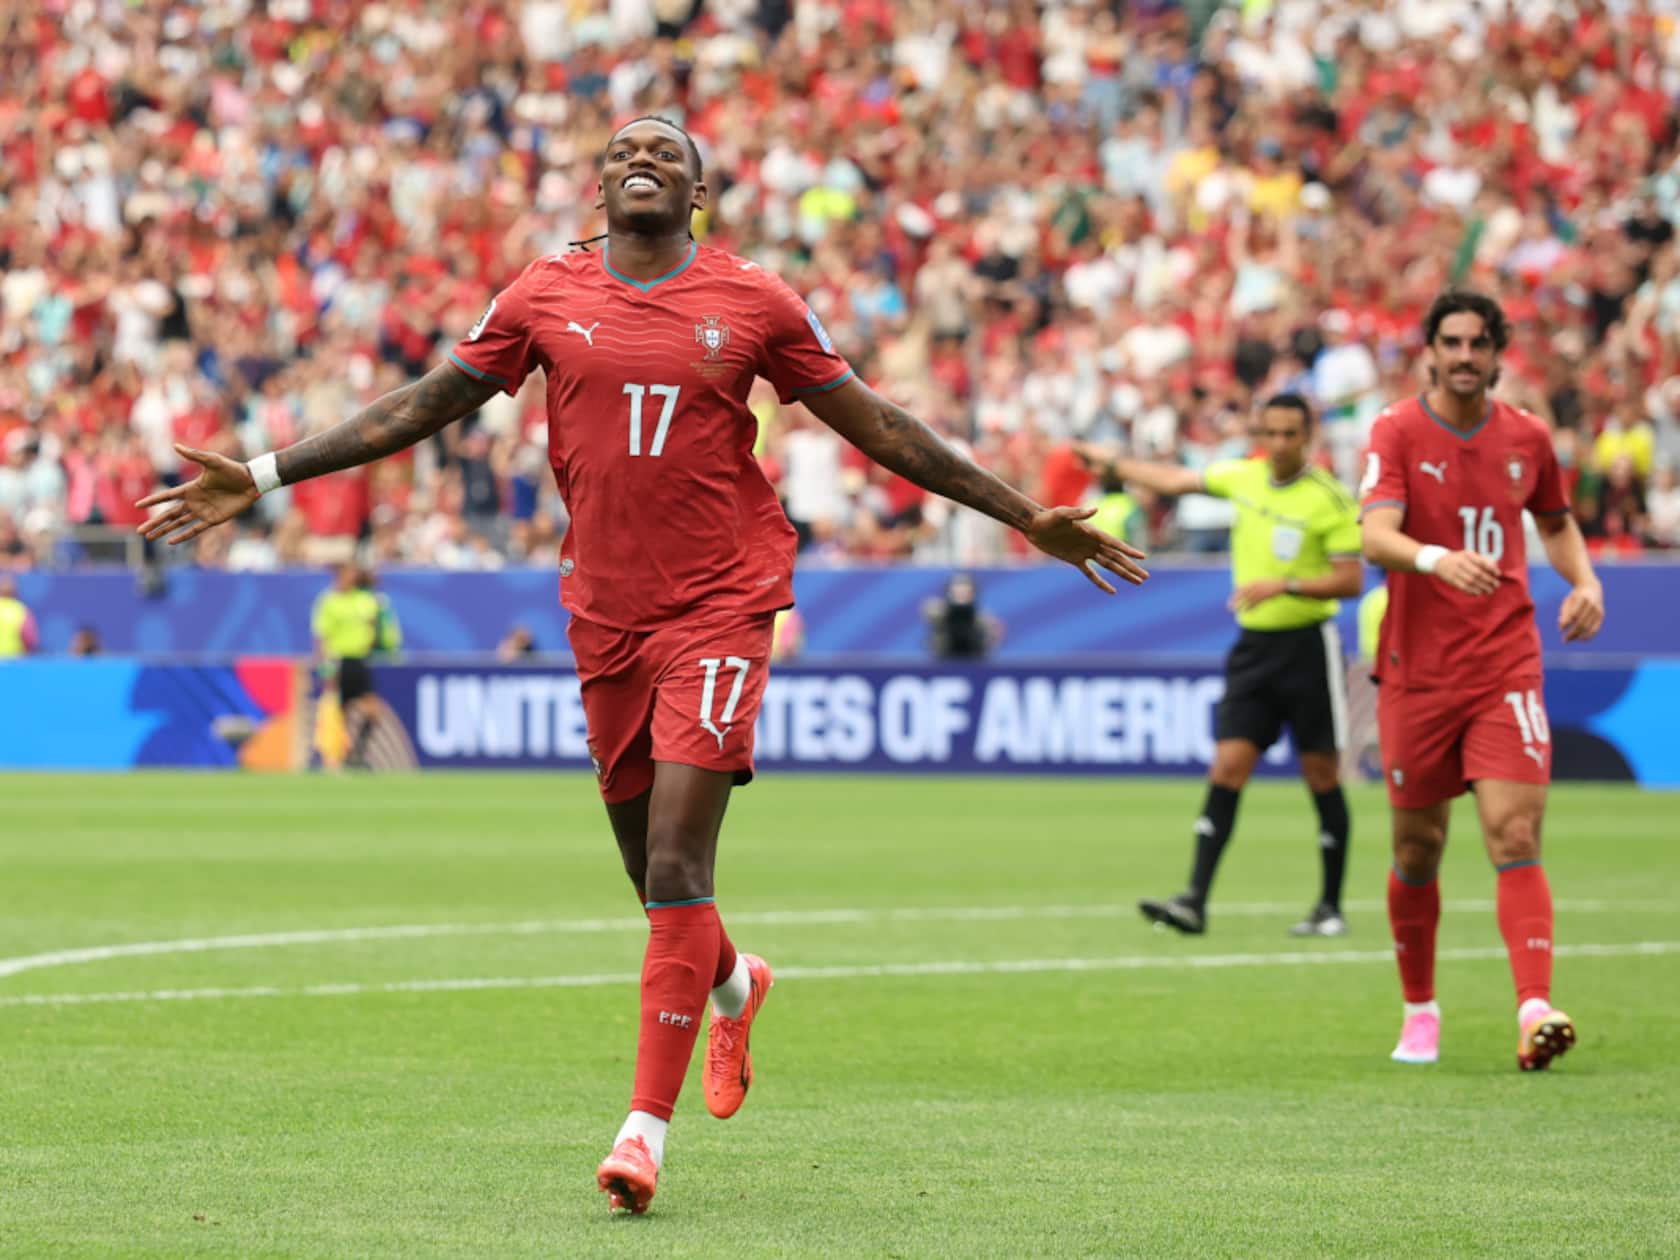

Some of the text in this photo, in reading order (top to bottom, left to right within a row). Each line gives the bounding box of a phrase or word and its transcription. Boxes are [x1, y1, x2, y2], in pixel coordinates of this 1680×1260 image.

[622, 383, 681, 457] 17
[1458, 506, 1504, 561] 16
[417, 675, 1291, 764] UNITE TES OF AMERIC
[699, 656, 750, 722] 17
[1504, 690, 1550, 743] 16
